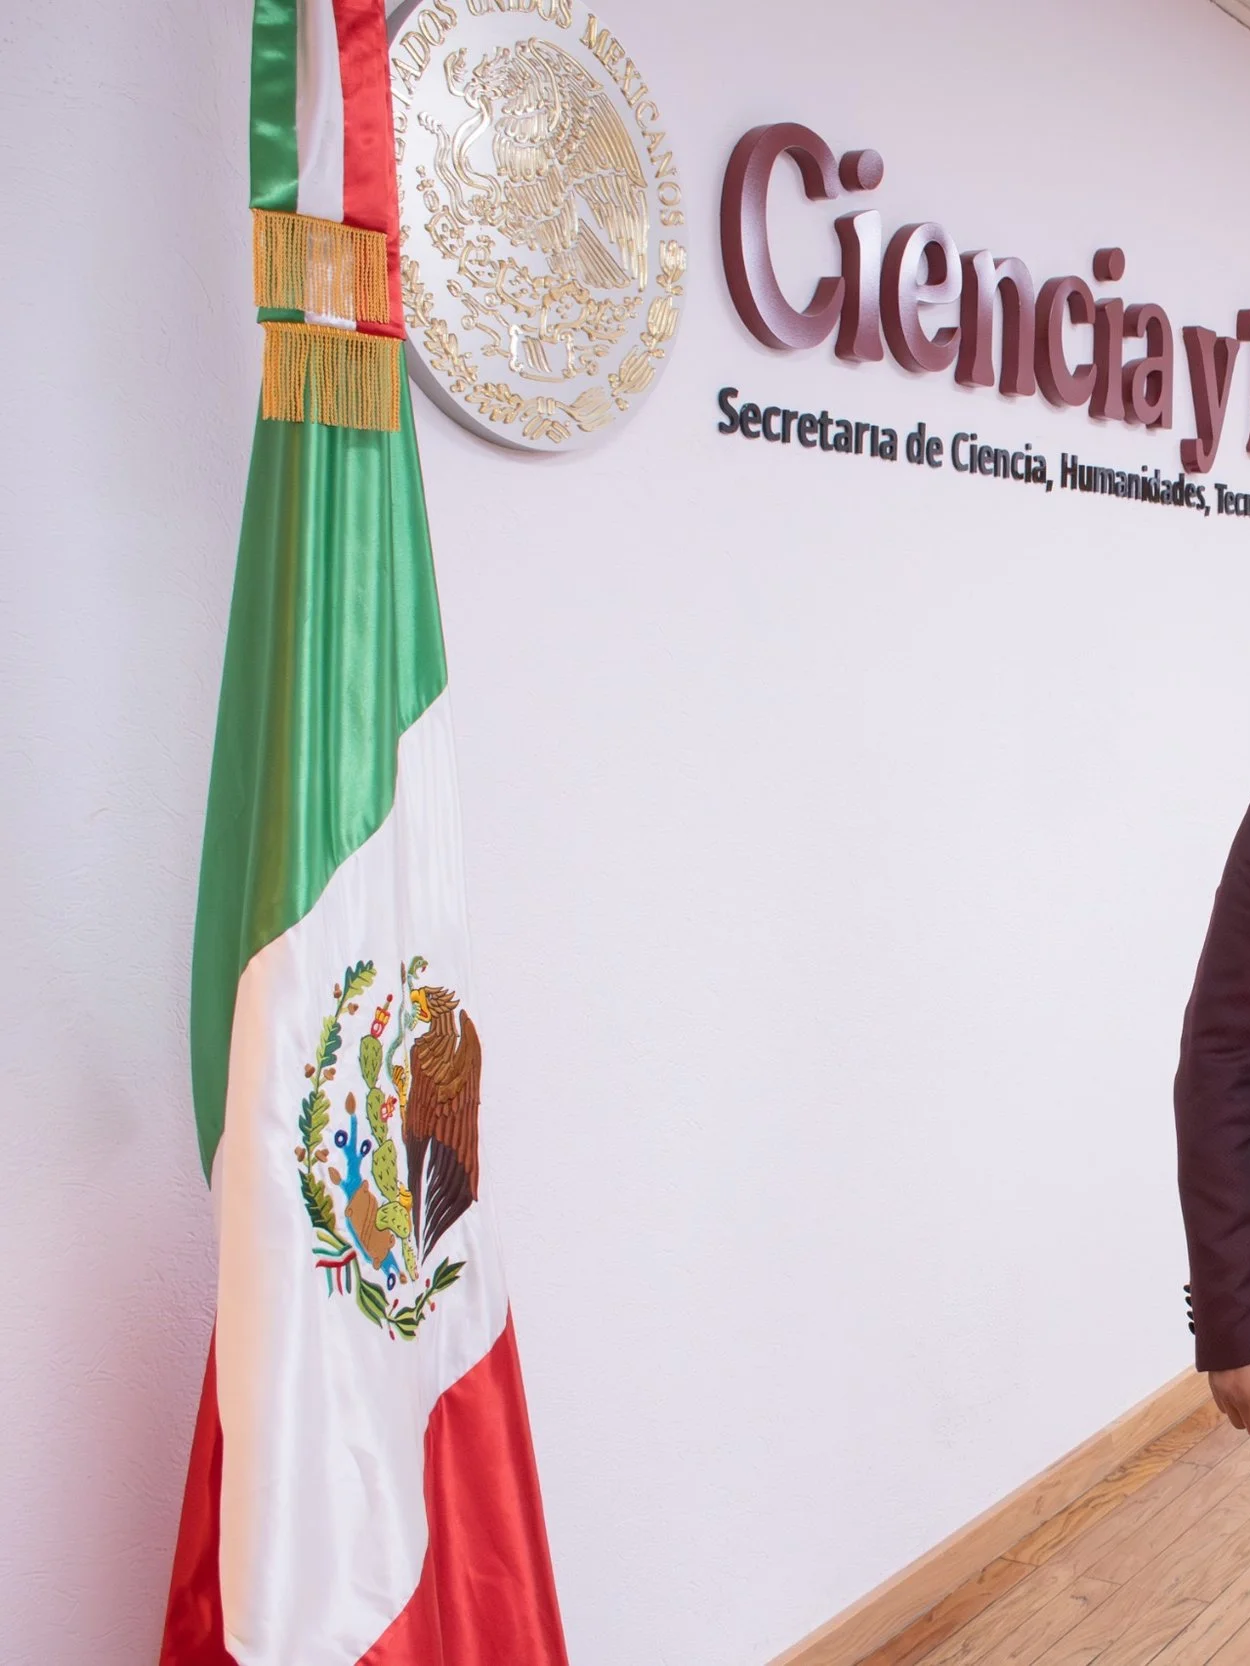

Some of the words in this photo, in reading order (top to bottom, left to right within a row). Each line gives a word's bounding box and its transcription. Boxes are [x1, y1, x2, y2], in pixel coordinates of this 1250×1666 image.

[579, 13, 685, 227] MEXICANOS
[719, 122, 1173, 430] Ciencia
[1179, 325, 1240, 474] y
[906, 422, 943, 469] de
[951, 432, 1054, 493] Ciencia,
[1060, 452, 1211, 517] Humanidades,
